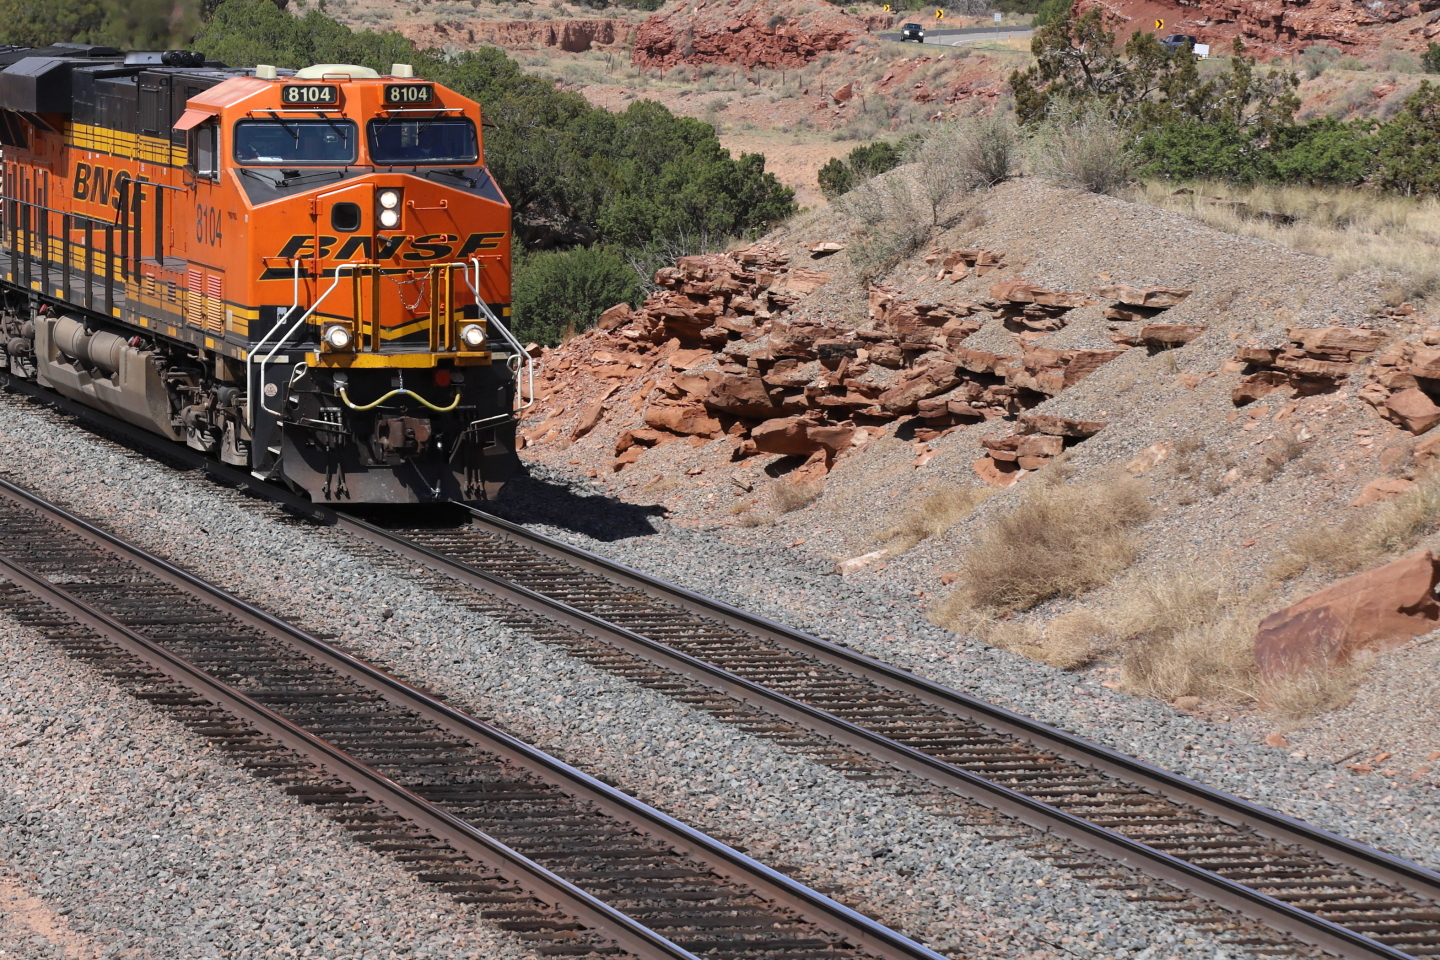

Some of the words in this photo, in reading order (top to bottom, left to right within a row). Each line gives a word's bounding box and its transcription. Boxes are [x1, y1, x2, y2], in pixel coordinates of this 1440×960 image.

[288, 86, 331, 102] 8104
[390, 86, 429, 101] 8104
[72, 161, 151, 215] BNSF
[196, 203, 223, 248] 8104
[274, 231, 508, 261] BNSF
